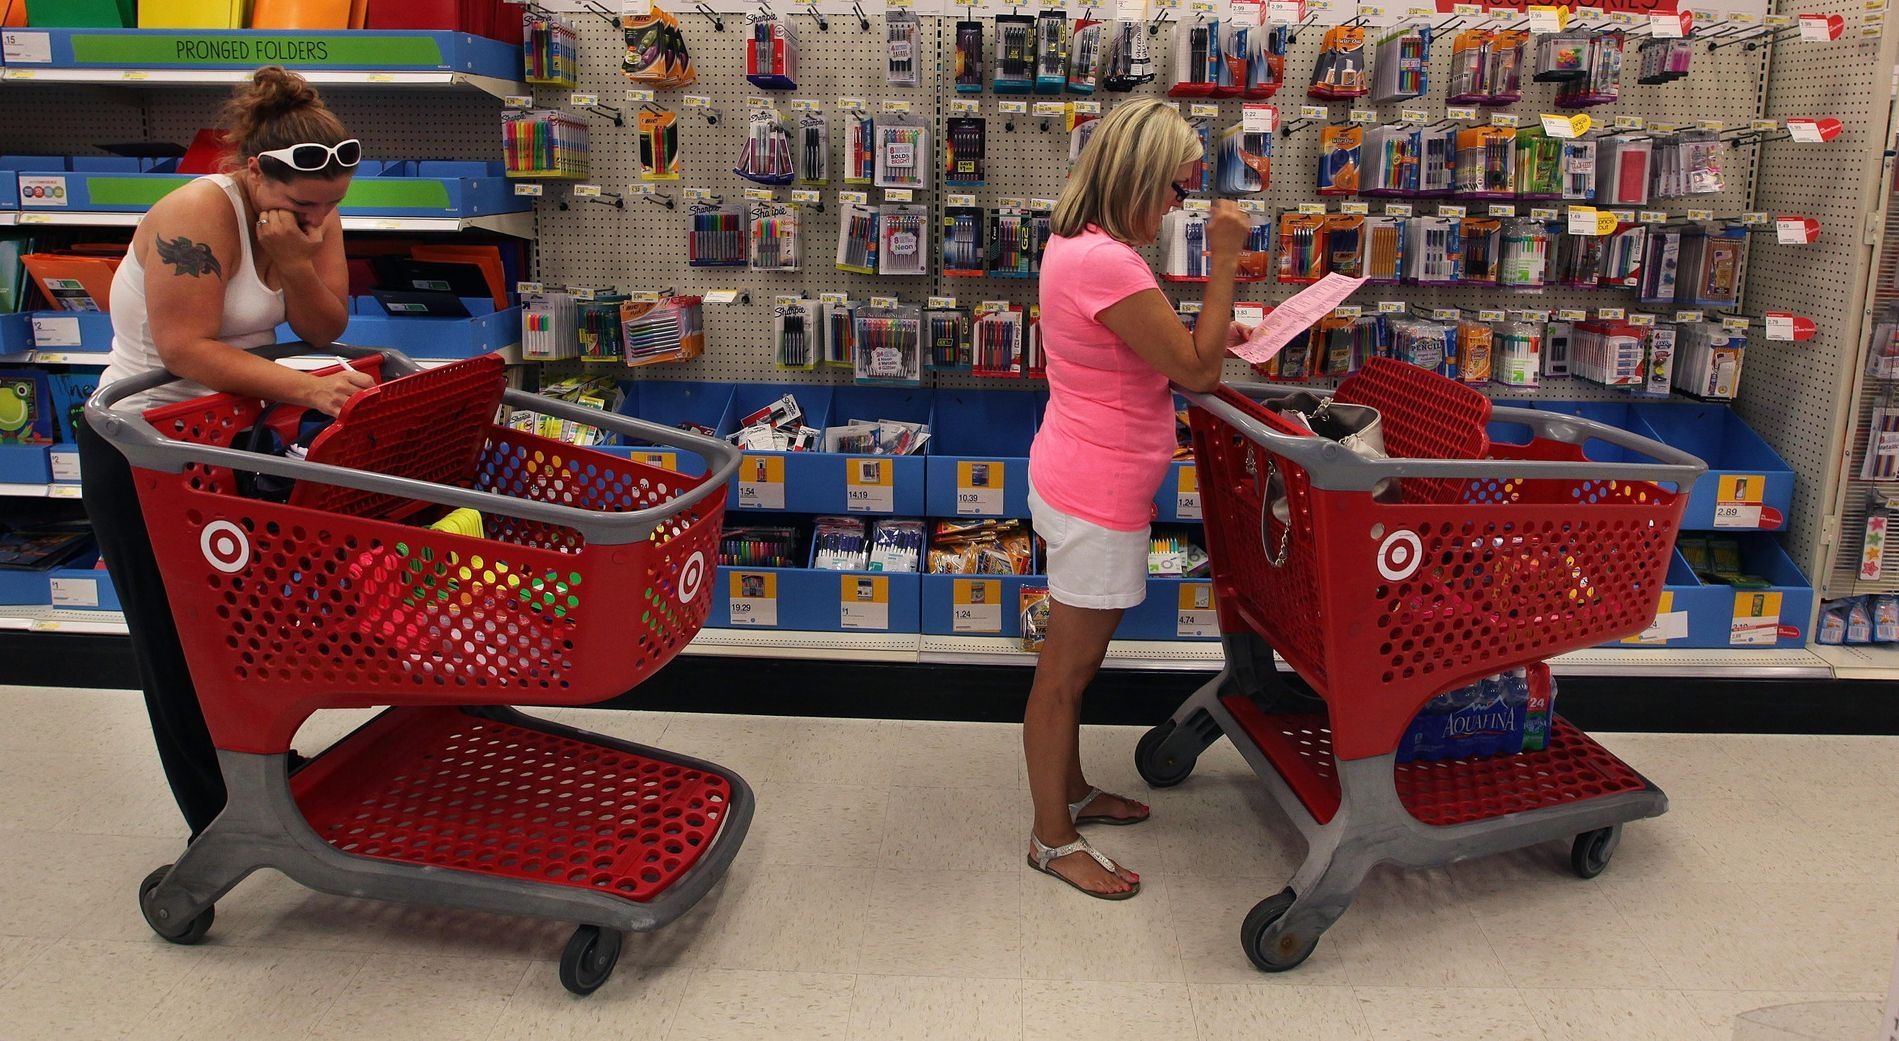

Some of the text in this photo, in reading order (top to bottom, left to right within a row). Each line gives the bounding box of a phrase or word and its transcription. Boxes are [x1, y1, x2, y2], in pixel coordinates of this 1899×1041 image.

[746, 13, 778, 26] Sharpie
[1027, 28, 1034, 48] G2
[176, 40, 328, 60] PRONGED FOLDERS
[1021, 227, 1029, 250] G2
[774, 305, 806, 319] Sharpie
[1411, 341, 1442, 352] PENCIL
[739, 487, 755, 496] 1.54
[848, 491, 868, 499] 14.19
[958, 494, 978, 502] 10.39
[1179, 498, 1194, 507] 1.24
[1717, 508, 1738, 517] 2.89
[731, 603, 751, 612] 19.29
[842, 607, 849, 615] $1
[955, 610, 971, 618] 1.24
[1179, 616, 1195, 624] 4.74
[1529, 697, 1545, 708] 24
[1442, 706, 1515, 738] AQUAFINA
